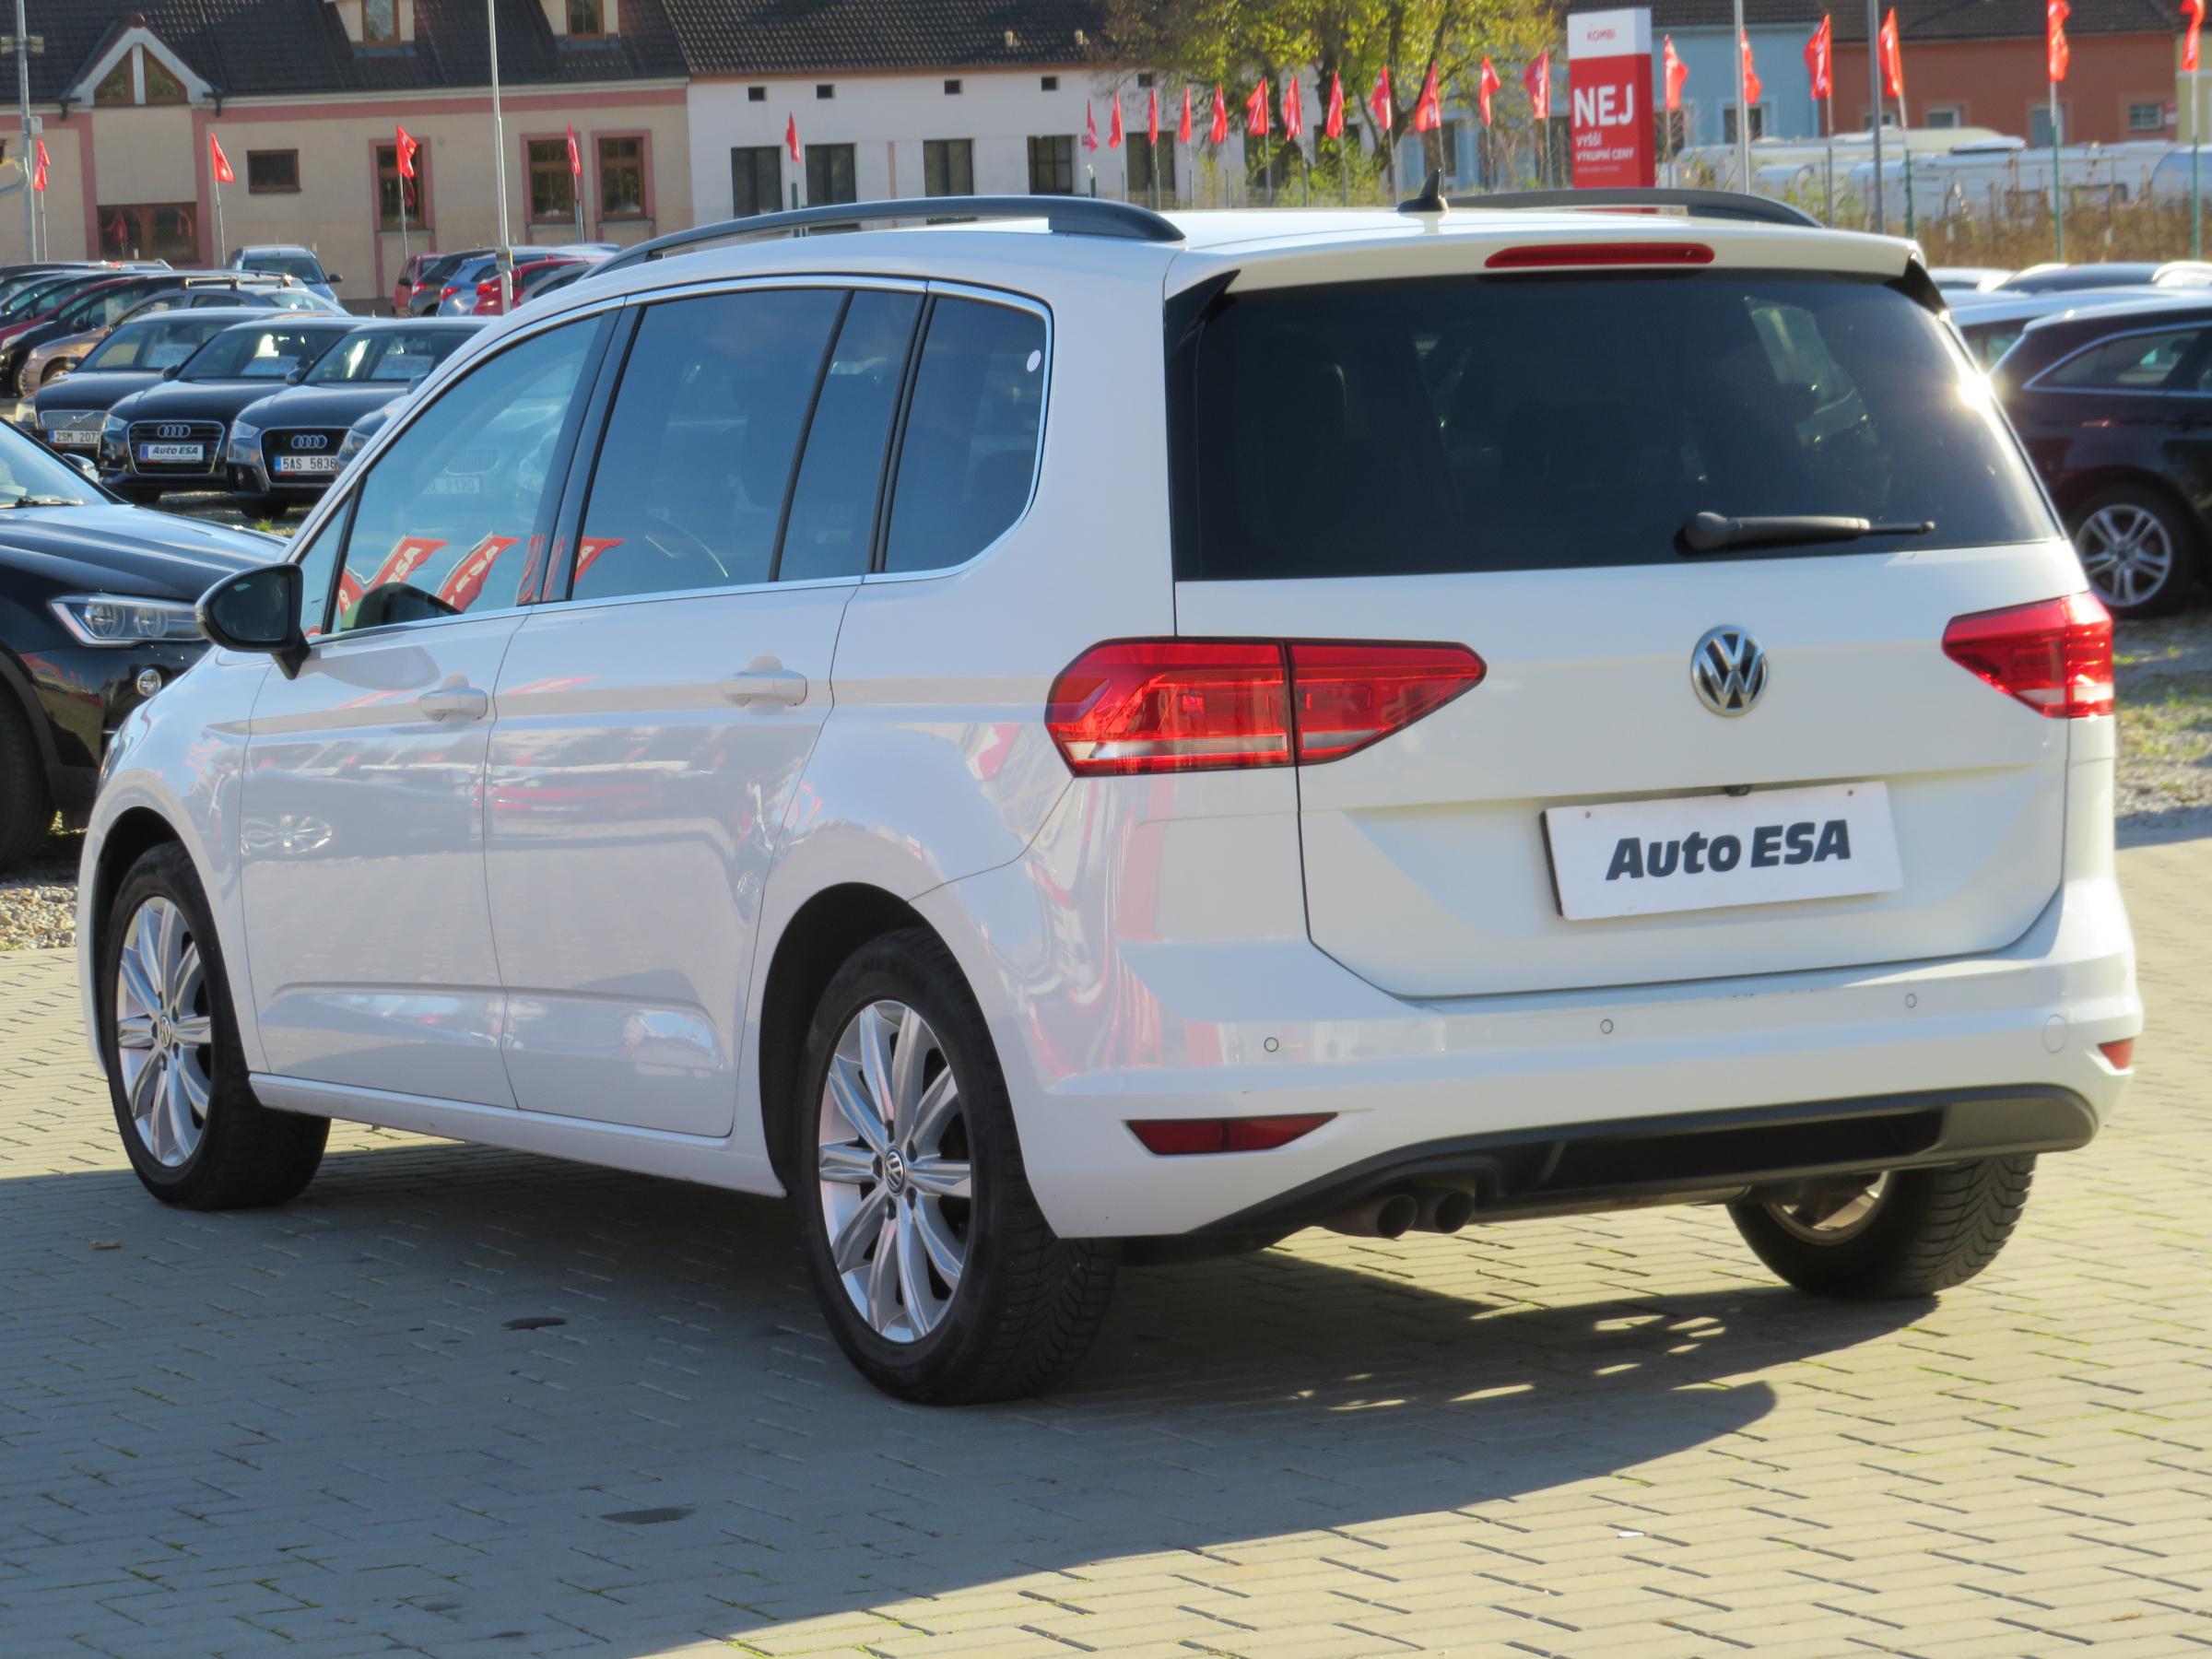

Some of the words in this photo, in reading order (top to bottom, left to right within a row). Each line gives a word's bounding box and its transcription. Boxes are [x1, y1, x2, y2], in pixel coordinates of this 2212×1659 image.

[1573, 84, 1634, 127] NEJ
[56, 431, 74, 442] 2SM
[152, 446, 177, 454] Auto
[179, 446, 198, 454] ESA
[283, 457, 302, 469] 5AS
[1606, 831, 1741, 881] Auto
[1750, 819, 1851, 868] ESA
